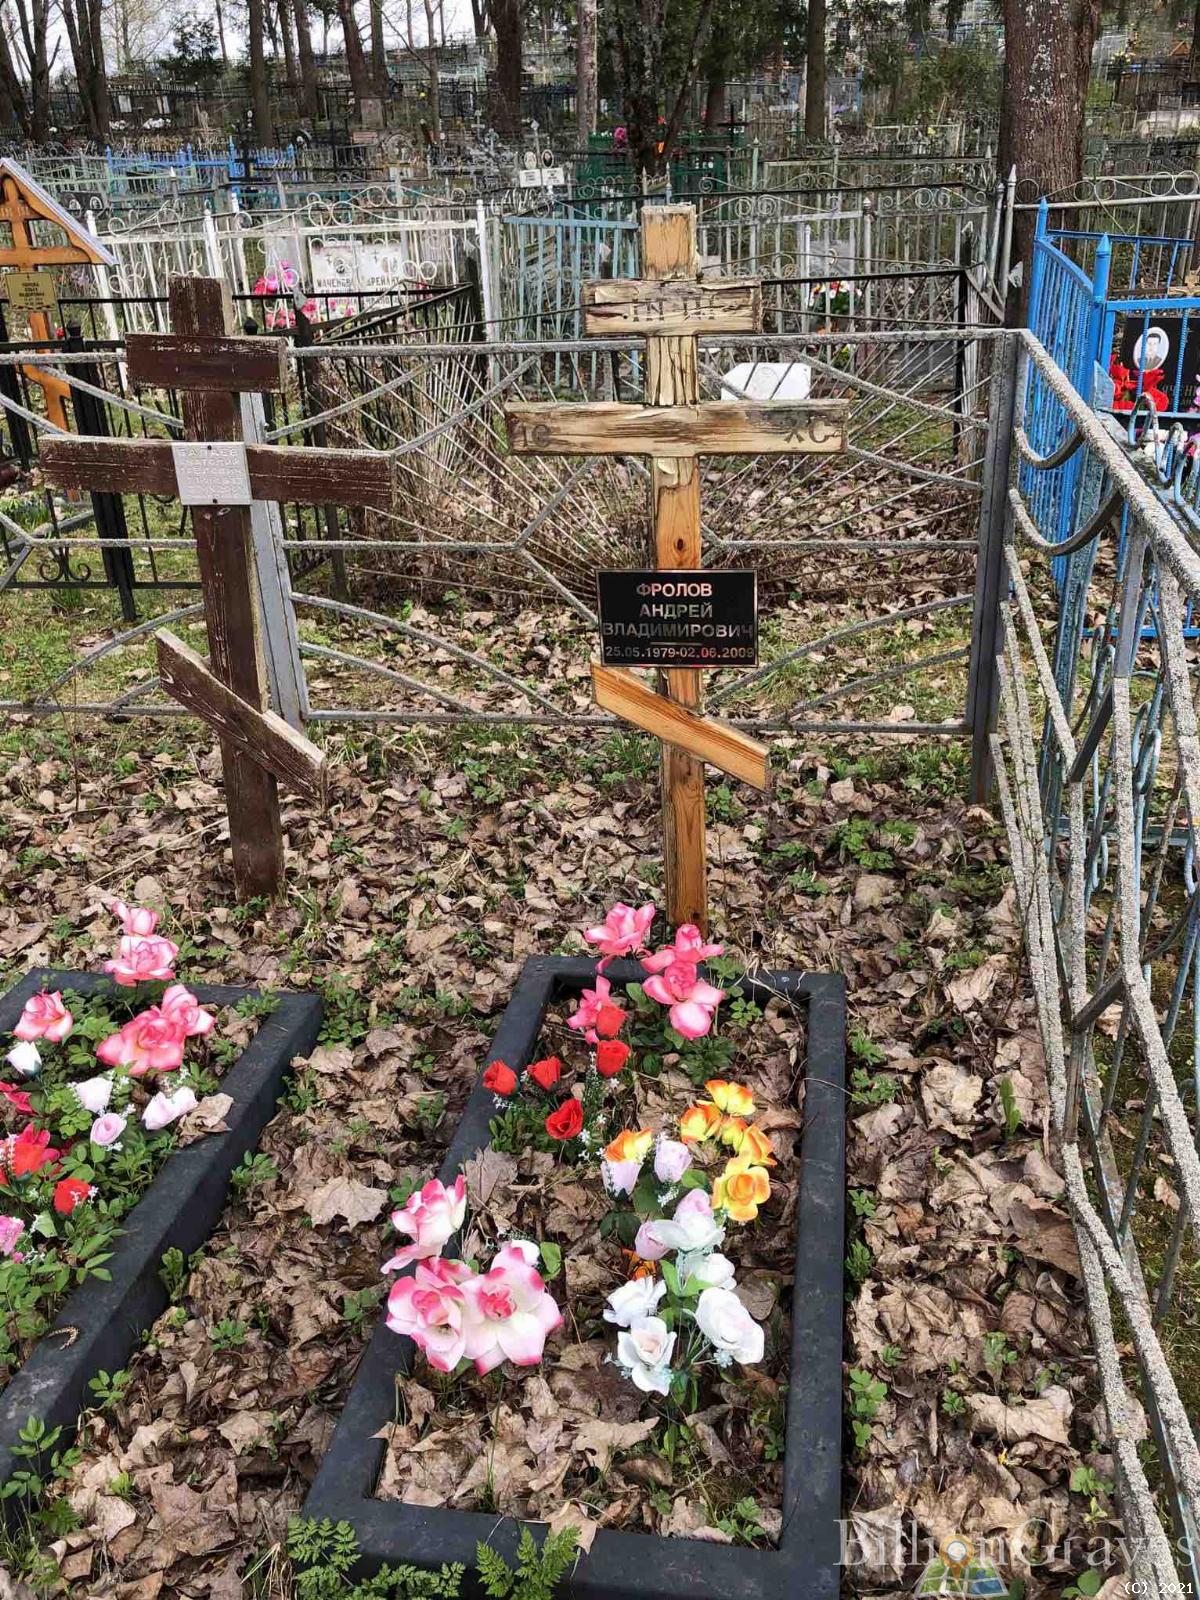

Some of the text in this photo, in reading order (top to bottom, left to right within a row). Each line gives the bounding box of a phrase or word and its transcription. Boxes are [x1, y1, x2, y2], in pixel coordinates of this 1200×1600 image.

[636, 583, 713, 597] ФРОЛОВ
[640, 602, 713, 619] АНДРЕЙ
[602, 622, 754, 638] ВЛАДИМИРОВИЧ
